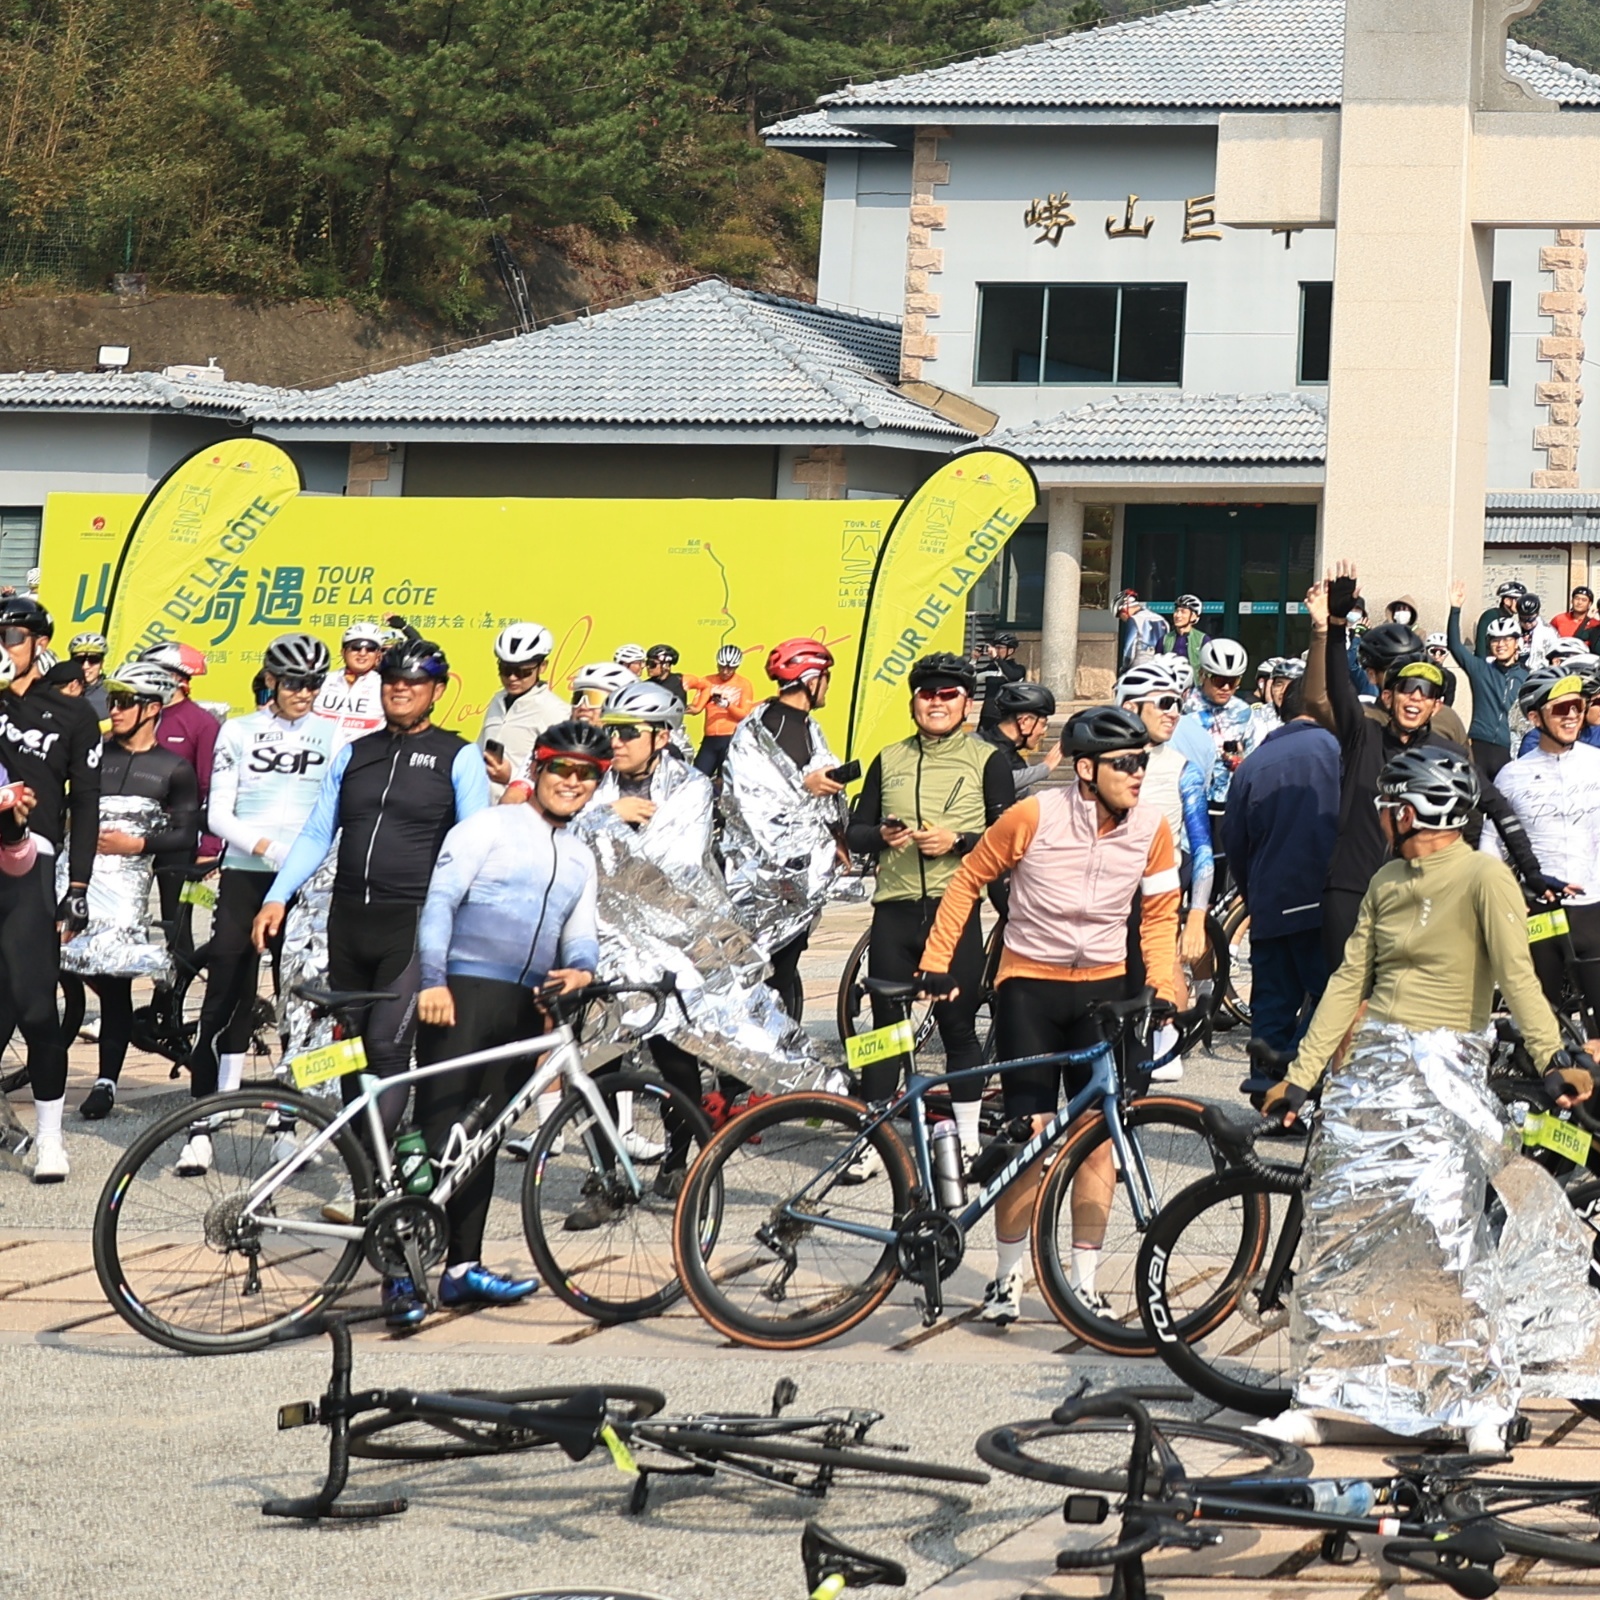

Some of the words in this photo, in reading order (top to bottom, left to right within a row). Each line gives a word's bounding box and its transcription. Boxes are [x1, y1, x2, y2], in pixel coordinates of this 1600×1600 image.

[162, 585, 204, 622] DE
[191, 556, 230, 590] LA
[219, 495, 280, 554] CÔTE
[317, 566, 375, 584] TOUR
[312, 587, 339, 605] DE
[348, 587, 374, 605] LA
[382, 579, 437, 606] CÔTE
[873, 627, 928, 687] TOUR
[914, 593, 953, 630] DE
[939, 563, 977, 598] LA
[965, 506, 1019, 564] CÔTE
[323, 695, 370, 714] UAE
[857, 1039, 885, 1058] A074
[1551, 1130, 1580, 1153] B158
[1149, 1245, 1178, 1343] roval
